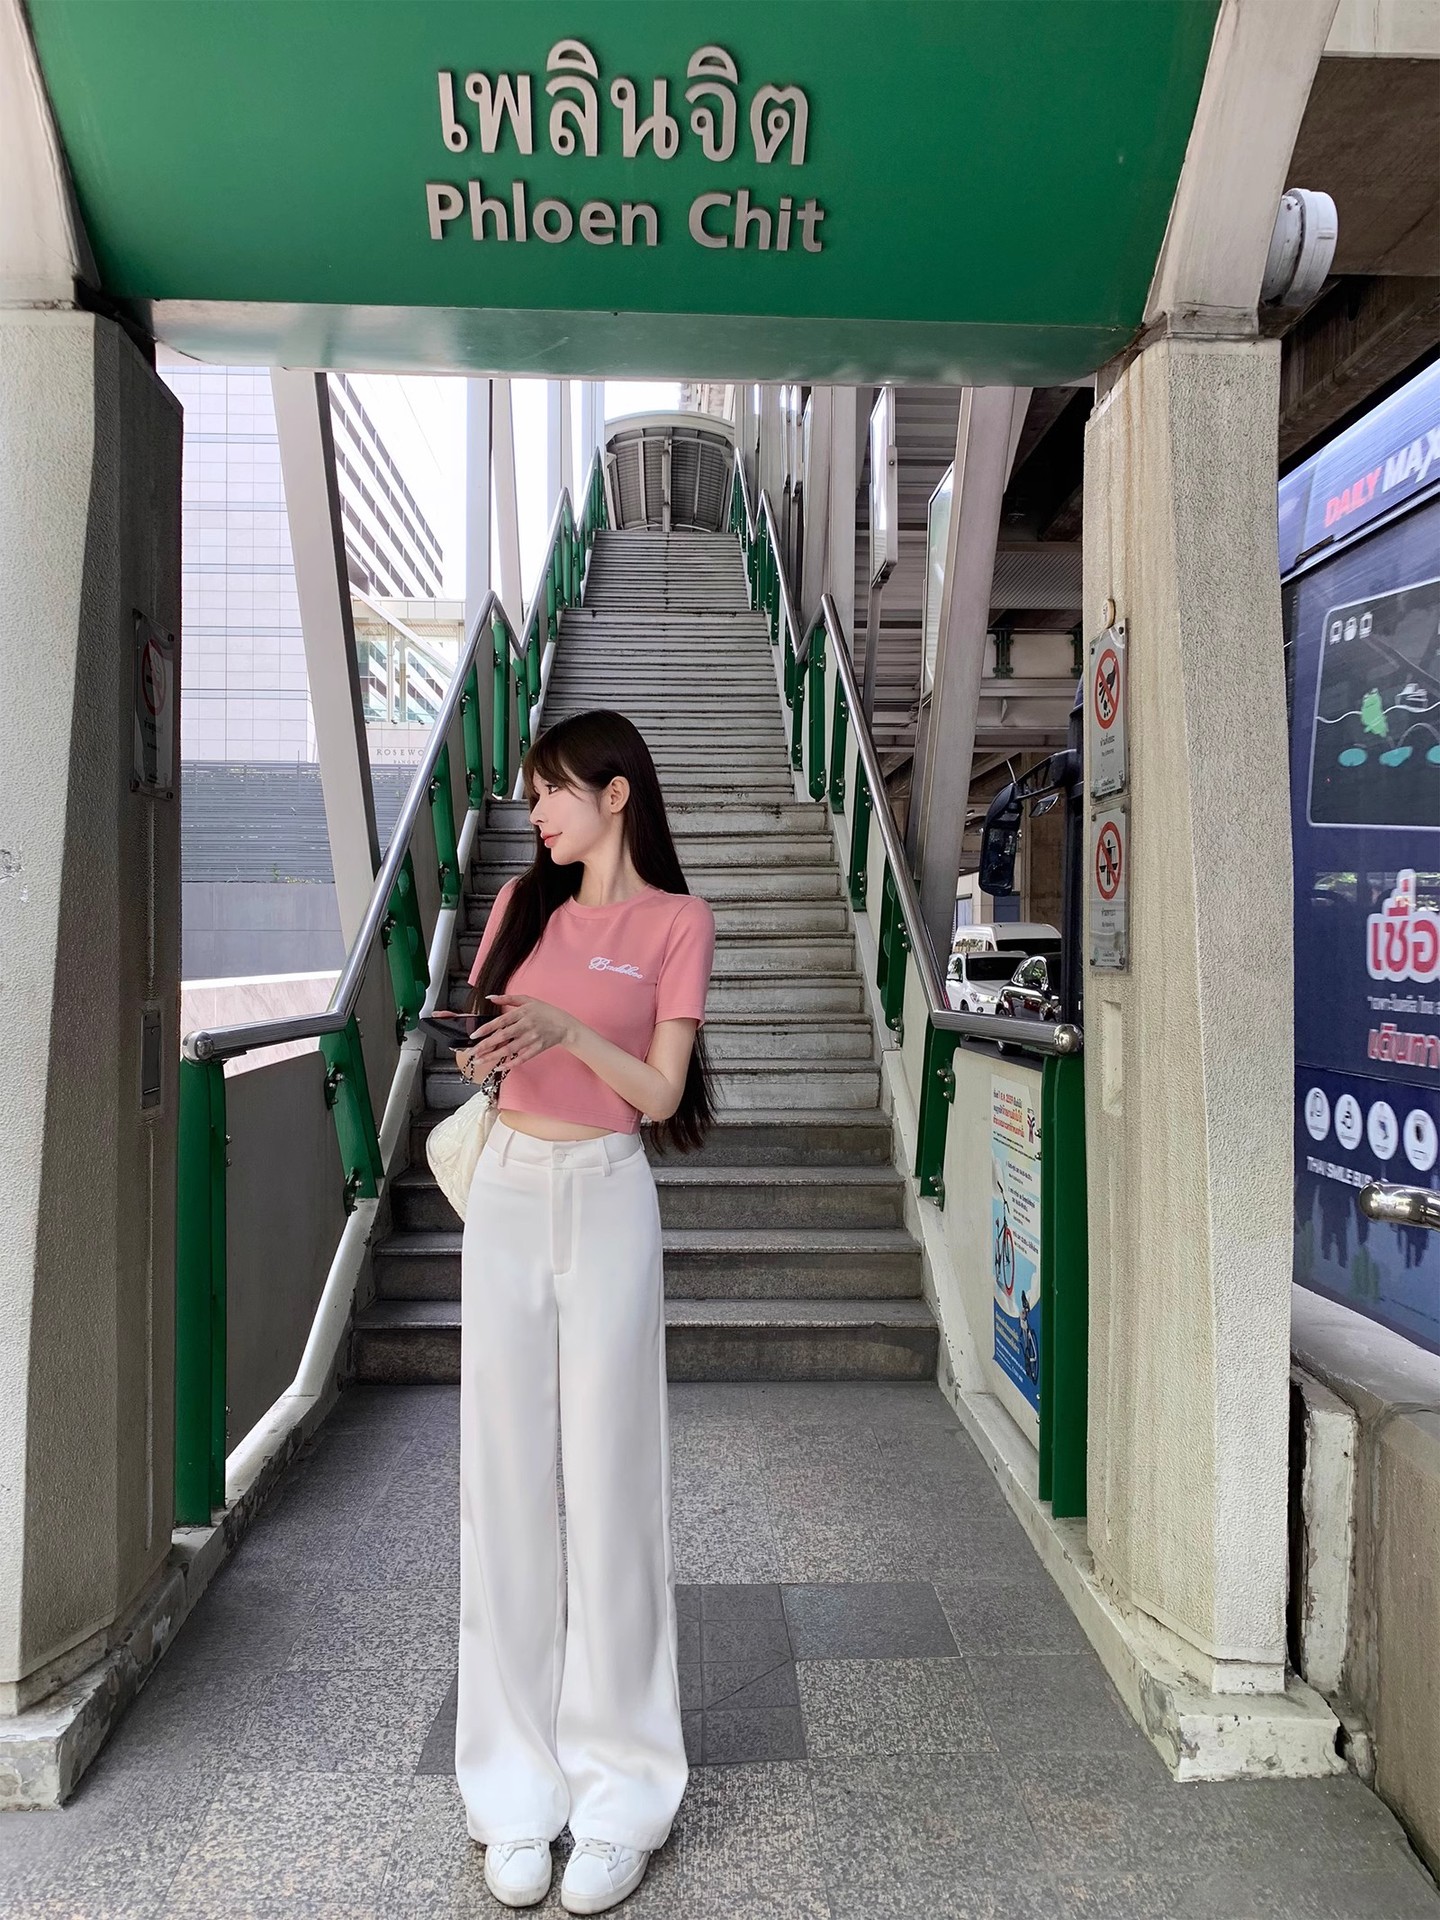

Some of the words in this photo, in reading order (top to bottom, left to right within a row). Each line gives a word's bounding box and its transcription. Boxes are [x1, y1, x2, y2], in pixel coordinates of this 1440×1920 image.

[437, 39, 810, 166] เพลินจิต
[425, 179, 660, 247] Phloen
[688, 187, 825, 253] Chit
[1325, 466, 1383, 528] DAILY
